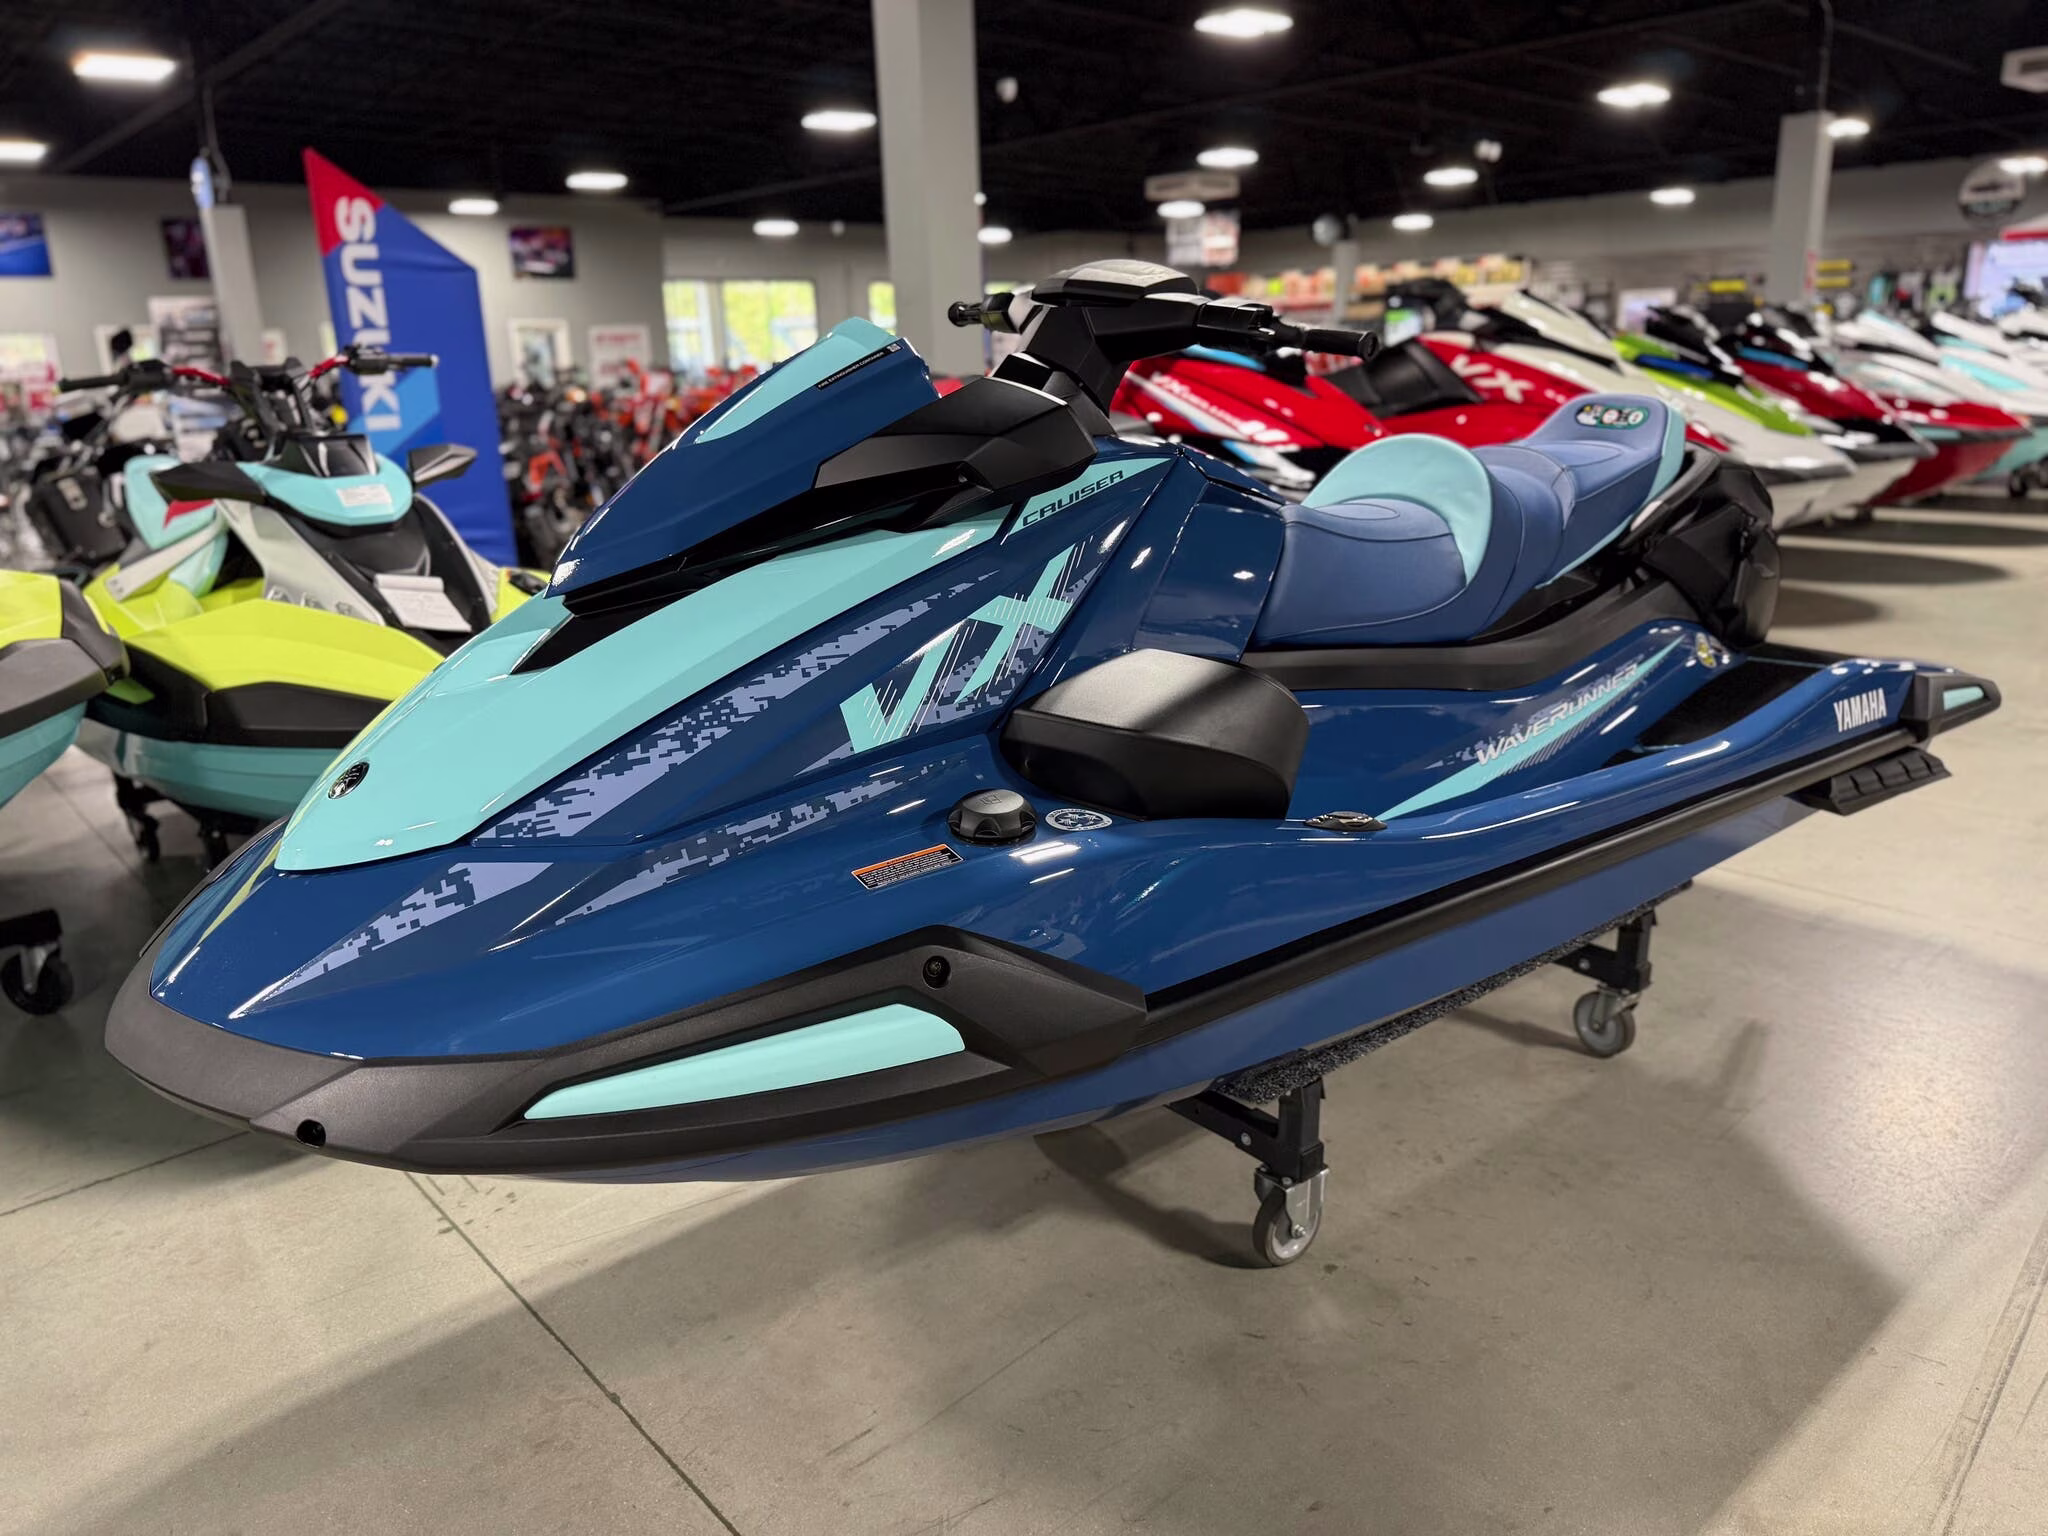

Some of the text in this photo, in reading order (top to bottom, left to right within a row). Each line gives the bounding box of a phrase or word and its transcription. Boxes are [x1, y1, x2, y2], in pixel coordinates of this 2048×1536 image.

[1450, 353, 1536, 404] VX
[1023, 469, 1124, 527] CRUISER
[839, 543, 1076, 754] VX
[1476, 663, 1639, 766] WAVERUNNER
[1833, 687, 1888, 733] YAMAHA
